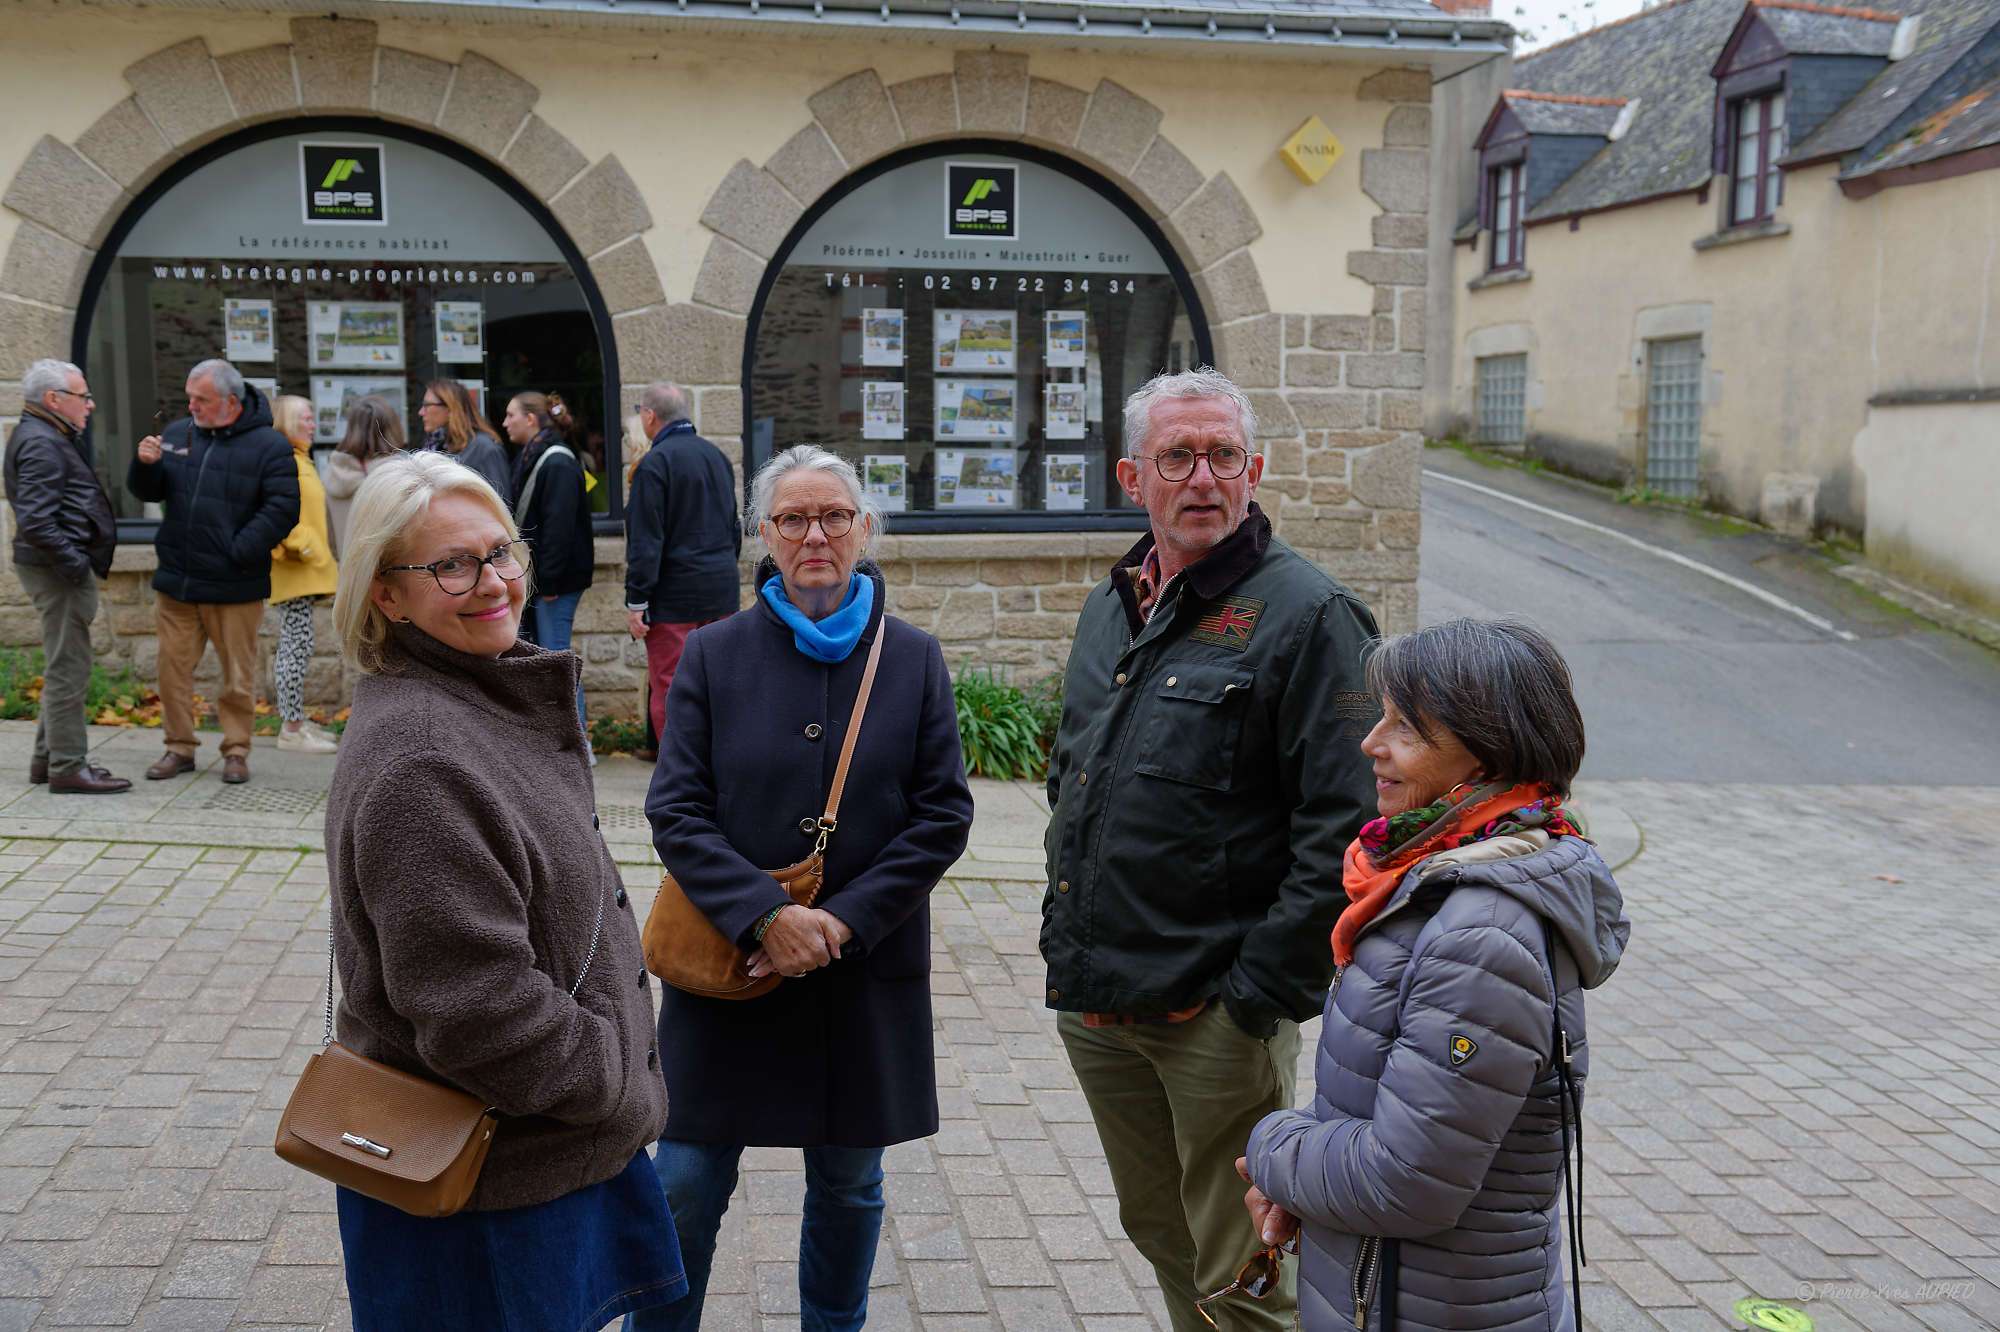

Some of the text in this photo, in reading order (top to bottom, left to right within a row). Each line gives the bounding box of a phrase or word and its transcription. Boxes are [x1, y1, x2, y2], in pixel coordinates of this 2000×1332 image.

[314, 191, 374, 207] BPS
[955, 209, 1008, 223] BPS
[239, 235, 449, 249] La référence habitat
[913, 248, 977, 259] Josselin
[1000, 250, 1076, 262] Malestroit
[1098, 252, 1131, 263] Guer
[153, 264, 535, 284] www.bretagne-proprietes.com
[825, 272, 877, 288] Tél.
[924, 275, 951, 290] 02
[971, 276, 998, 290] 97
[1017, 277, 1044, 292] 22
[1064, 278, 1089, 292] 34
[1109, 280, 1135, 293] 34
